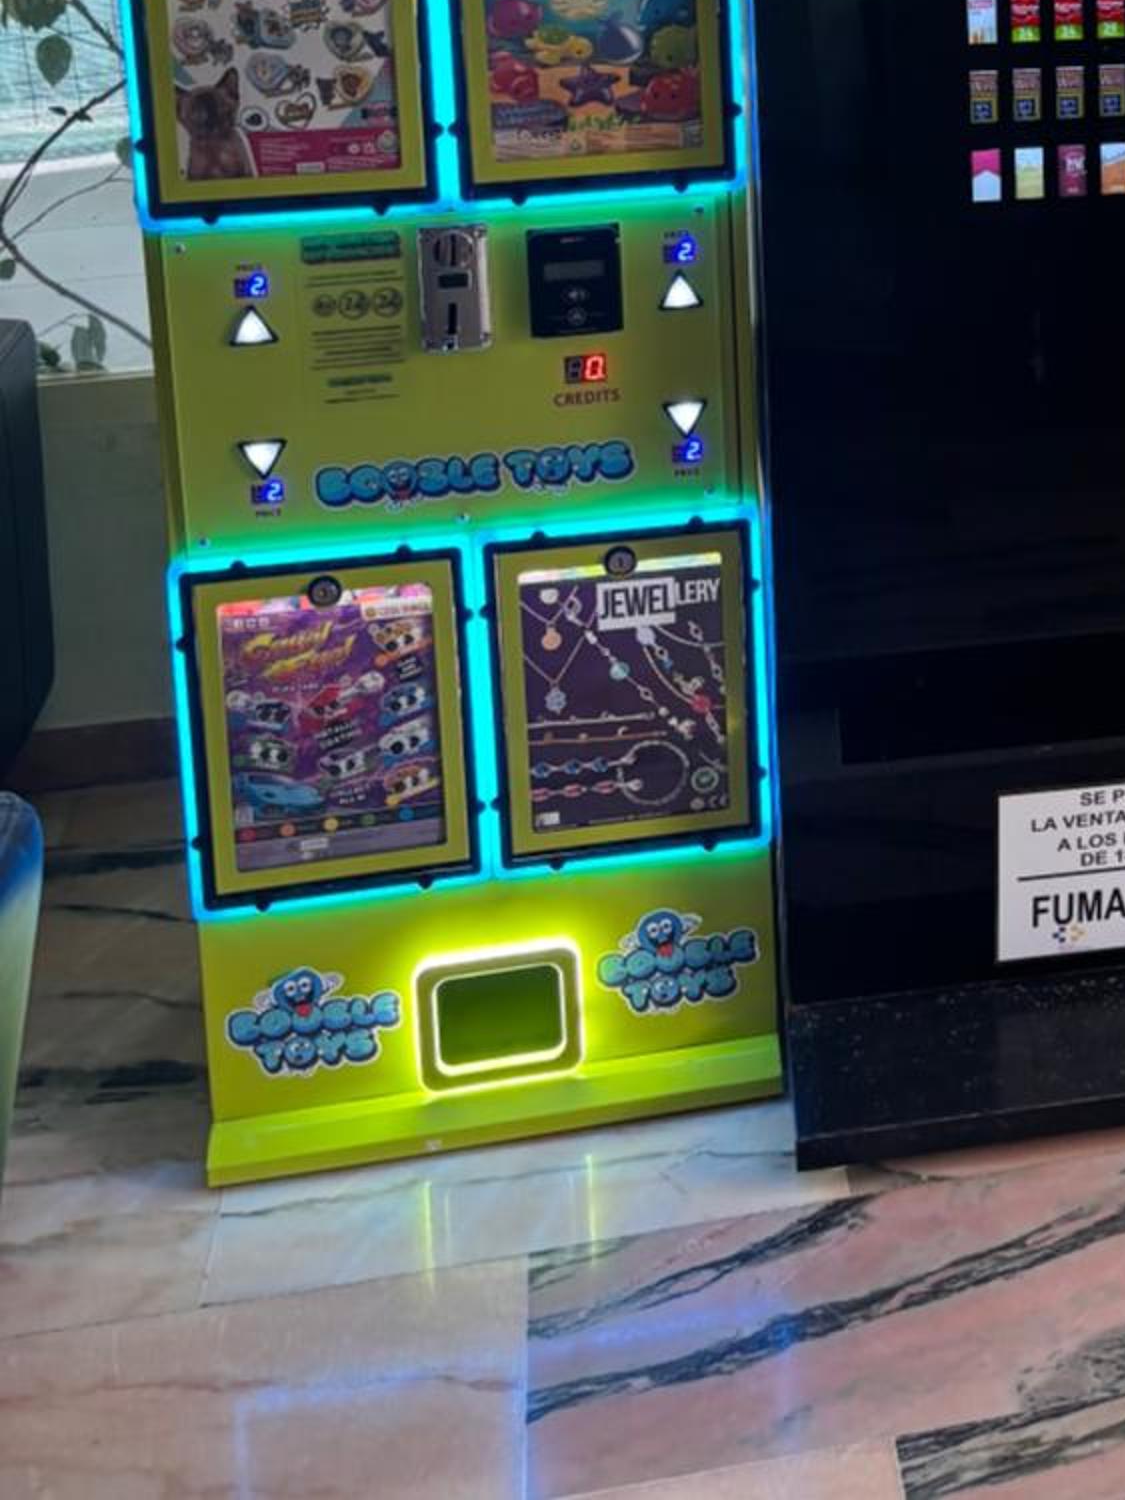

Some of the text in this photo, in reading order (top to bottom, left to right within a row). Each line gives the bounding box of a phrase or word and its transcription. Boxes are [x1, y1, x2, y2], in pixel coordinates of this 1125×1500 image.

[678, 242, 694, 261] 2
[553, 388, 621, 407] CREDITS
[686, 441, 702, 460] 2
[504, 440, 634, 488] TOYS
[1080, 791, 1105, 806] SE
[1031, 817, 1057, 833] LA
[1057, 838, 1071, 852] A
[1077, 832, 1117, 850] LOS
[1080, 852, 1108, 867] DE
[623, 964, 737, 1012] TOYS
[254, 1028, 378, 1074] TOYS
